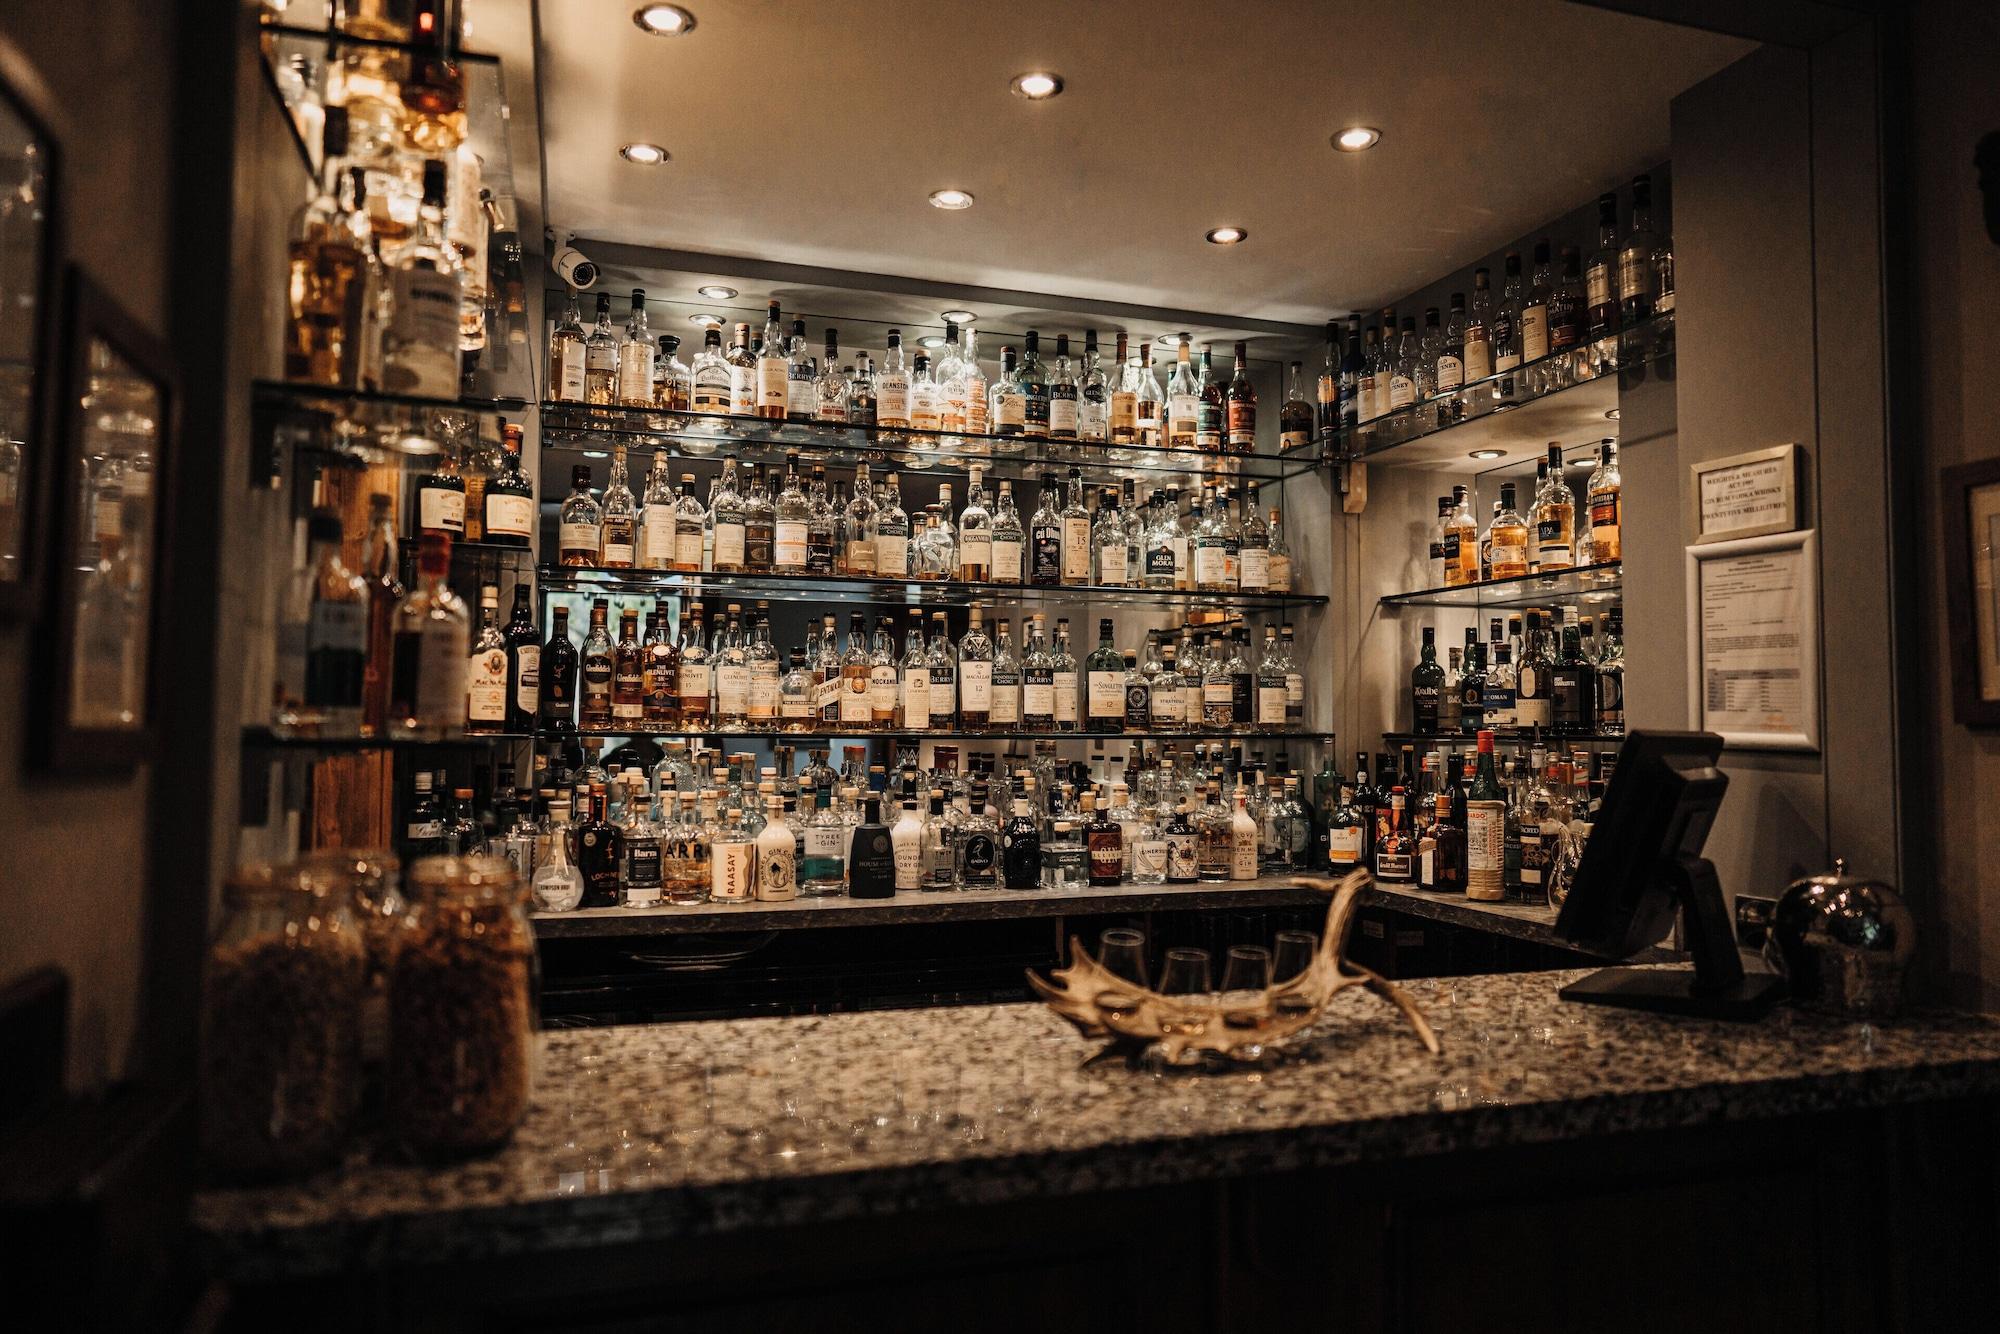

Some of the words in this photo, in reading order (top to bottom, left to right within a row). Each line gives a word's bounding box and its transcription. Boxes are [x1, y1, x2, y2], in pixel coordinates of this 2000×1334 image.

[1077, 536, 1087, 545] 15
[633, 848, 658, 859] Barra
[727, 853, 737, 895] RAASAY
